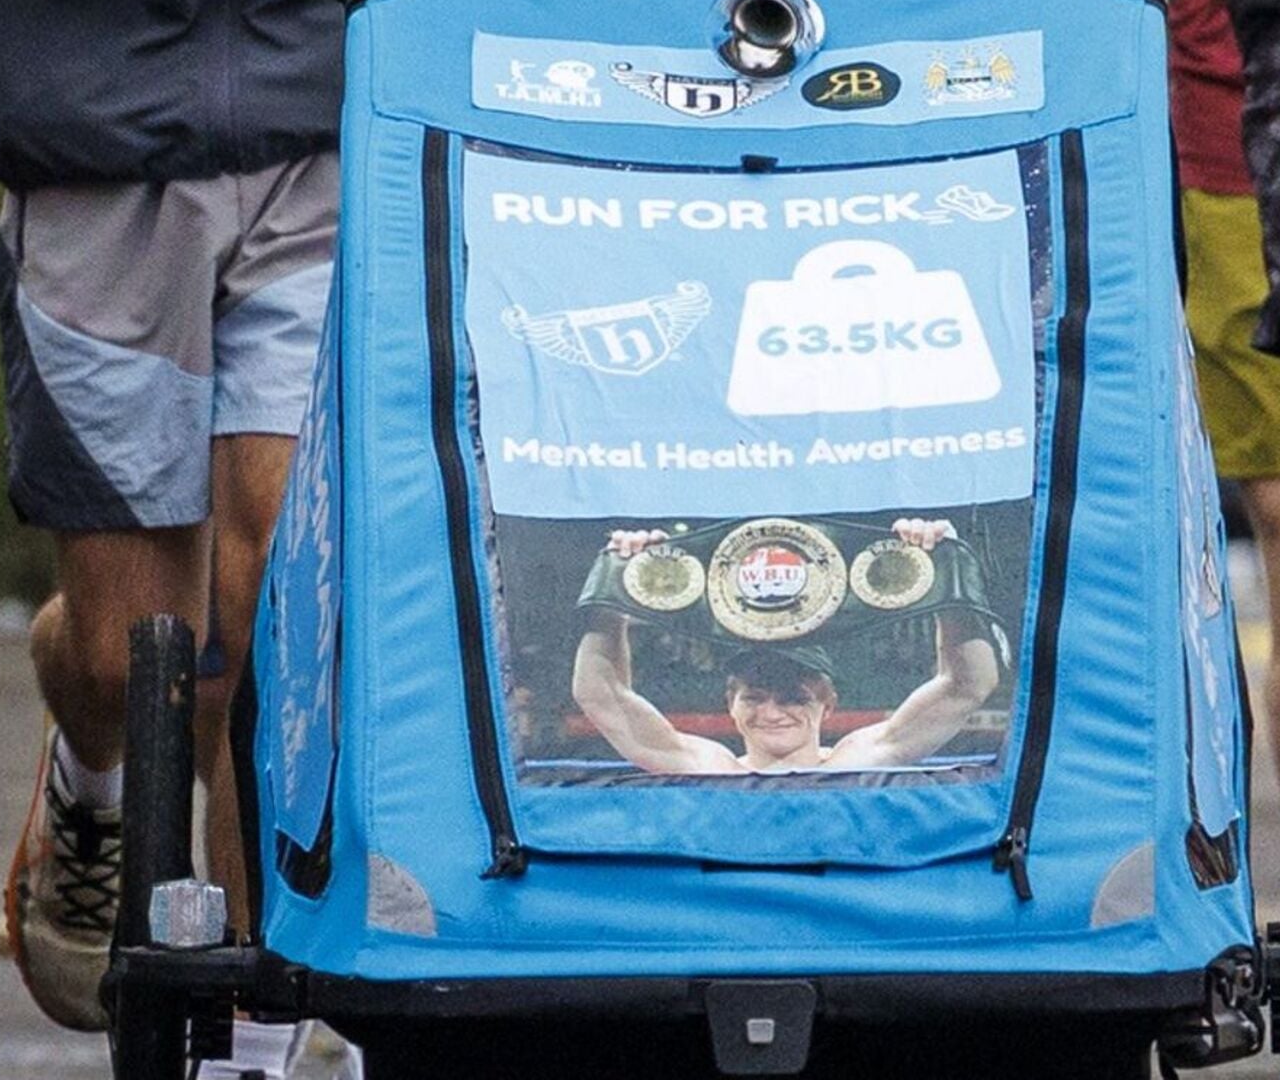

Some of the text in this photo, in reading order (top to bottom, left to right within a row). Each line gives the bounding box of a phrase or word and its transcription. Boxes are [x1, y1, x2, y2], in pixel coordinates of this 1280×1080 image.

[491, 191, 922, 230] RUN FOR RICK
[756, 317, 963, 357] 63.5KG
[502, 426, 1026, 470] Mental Health Awareness
